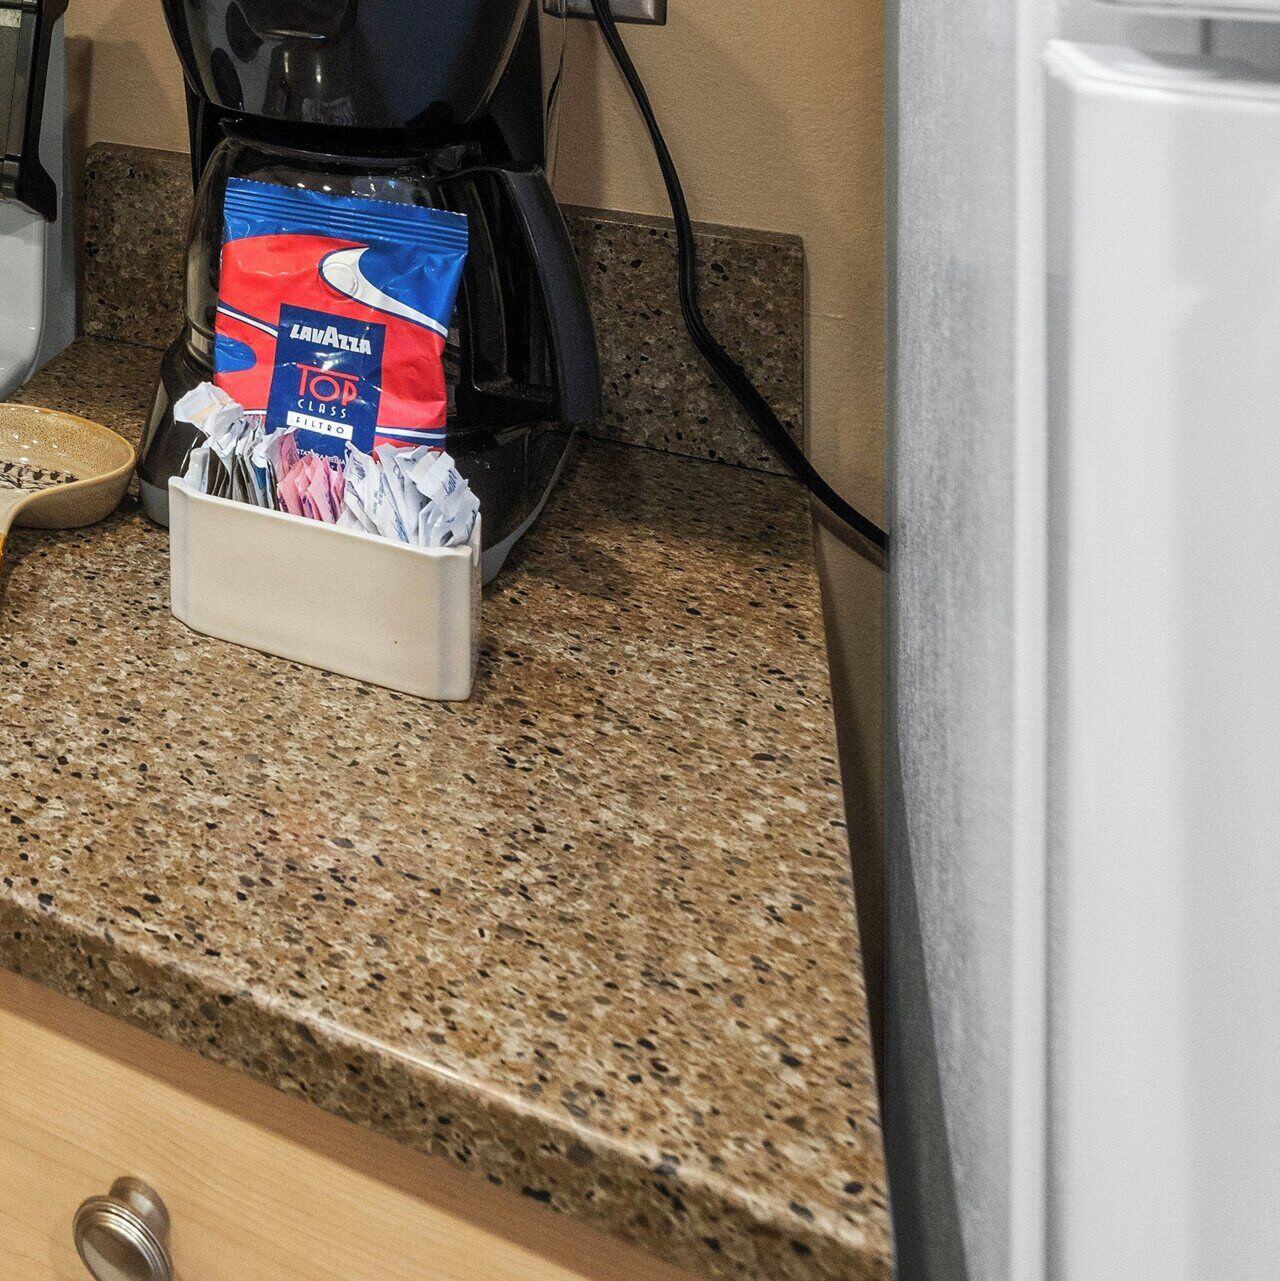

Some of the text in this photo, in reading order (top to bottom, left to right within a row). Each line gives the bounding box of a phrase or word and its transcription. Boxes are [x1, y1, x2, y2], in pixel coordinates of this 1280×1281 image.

[290, 324, 372, 355] LAVAZZA
[296, 363, 360, 406] TOP
[298, 399, 347, 419] CLASS
[296, 417, 345, 434] FILTRO
